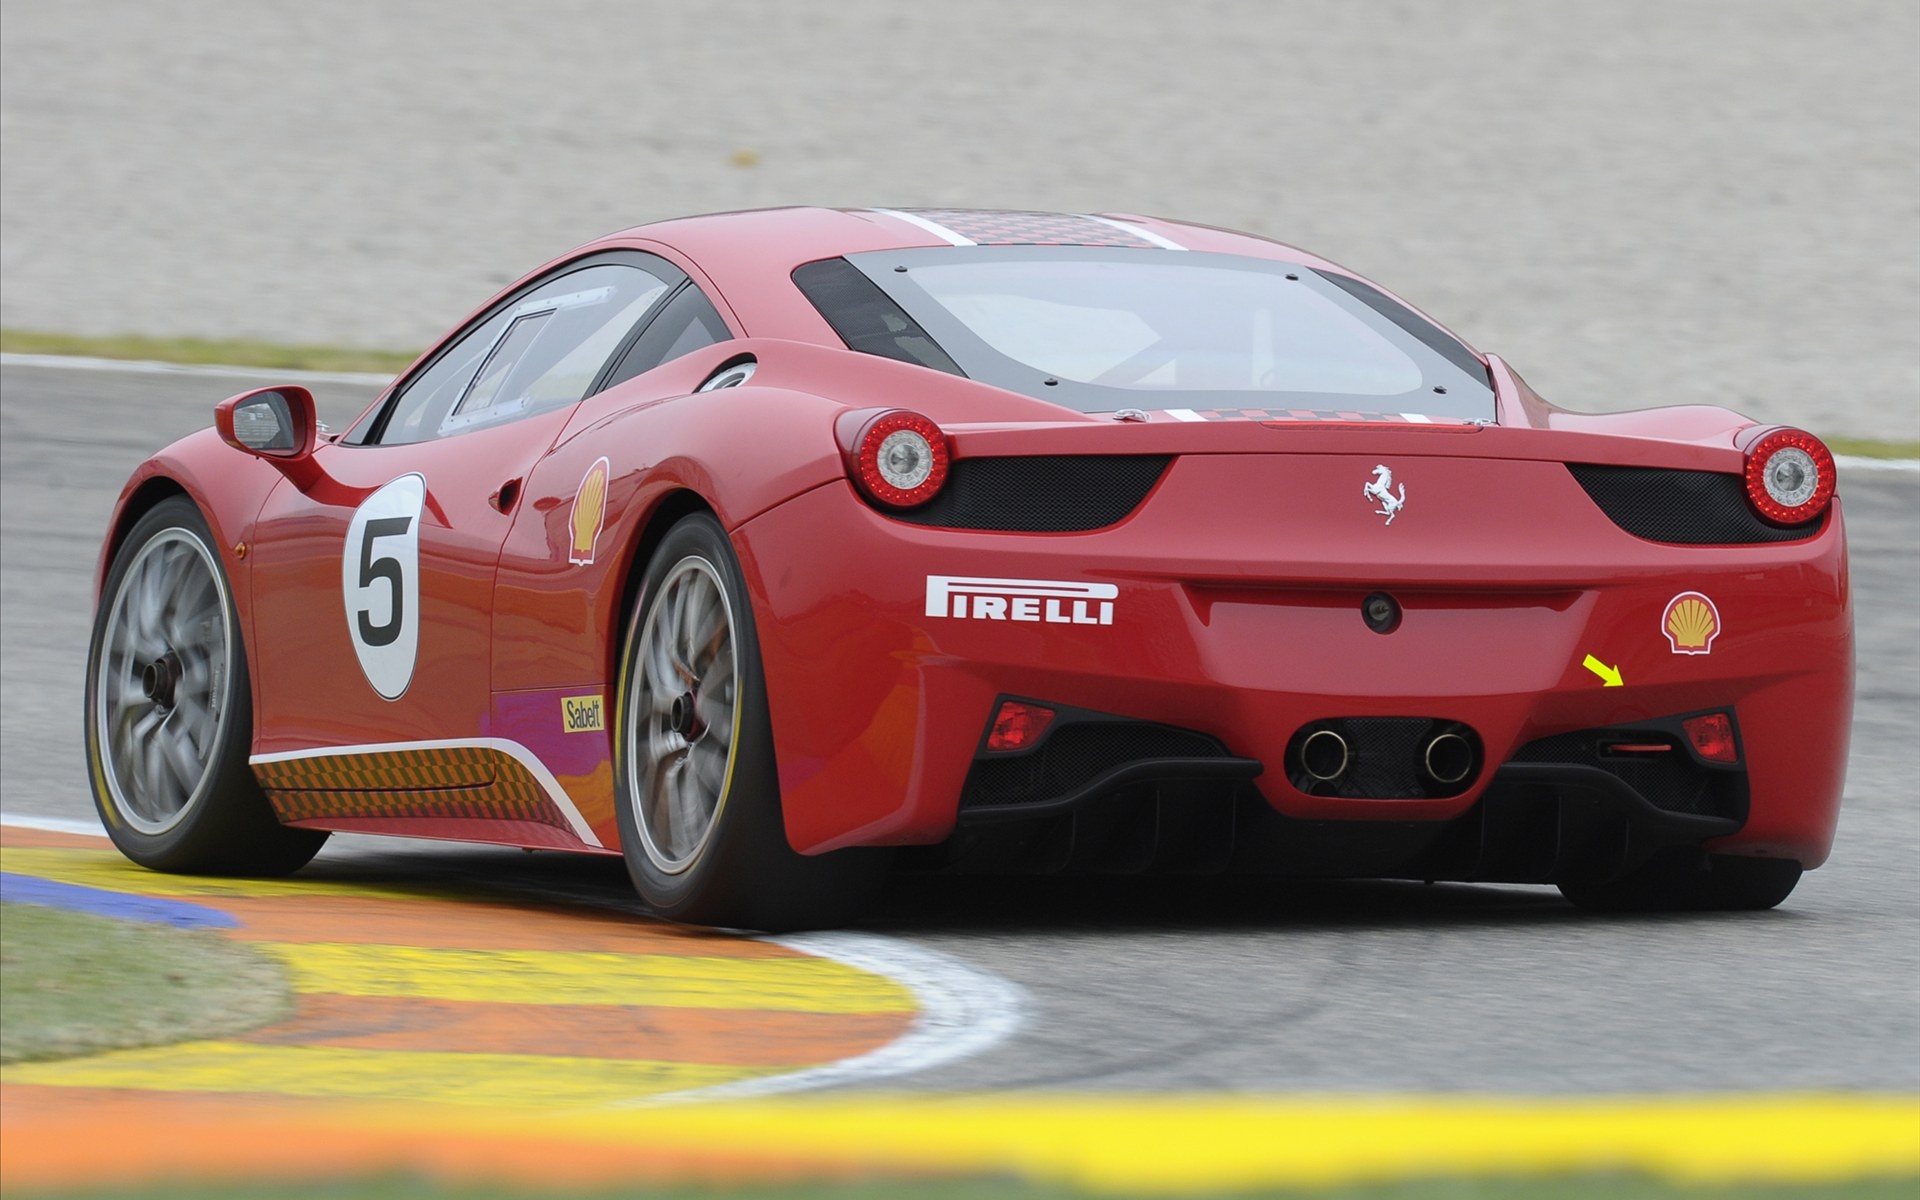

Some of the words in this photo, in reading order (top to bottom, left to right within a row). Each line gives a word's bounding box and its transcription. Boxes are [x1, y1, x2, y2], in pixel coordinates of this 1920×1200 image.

[357, 516, 413, 647] 5
[925, 575, 1119, 625] PIRELLI
[566, 700, 600, 729] Sabelt
